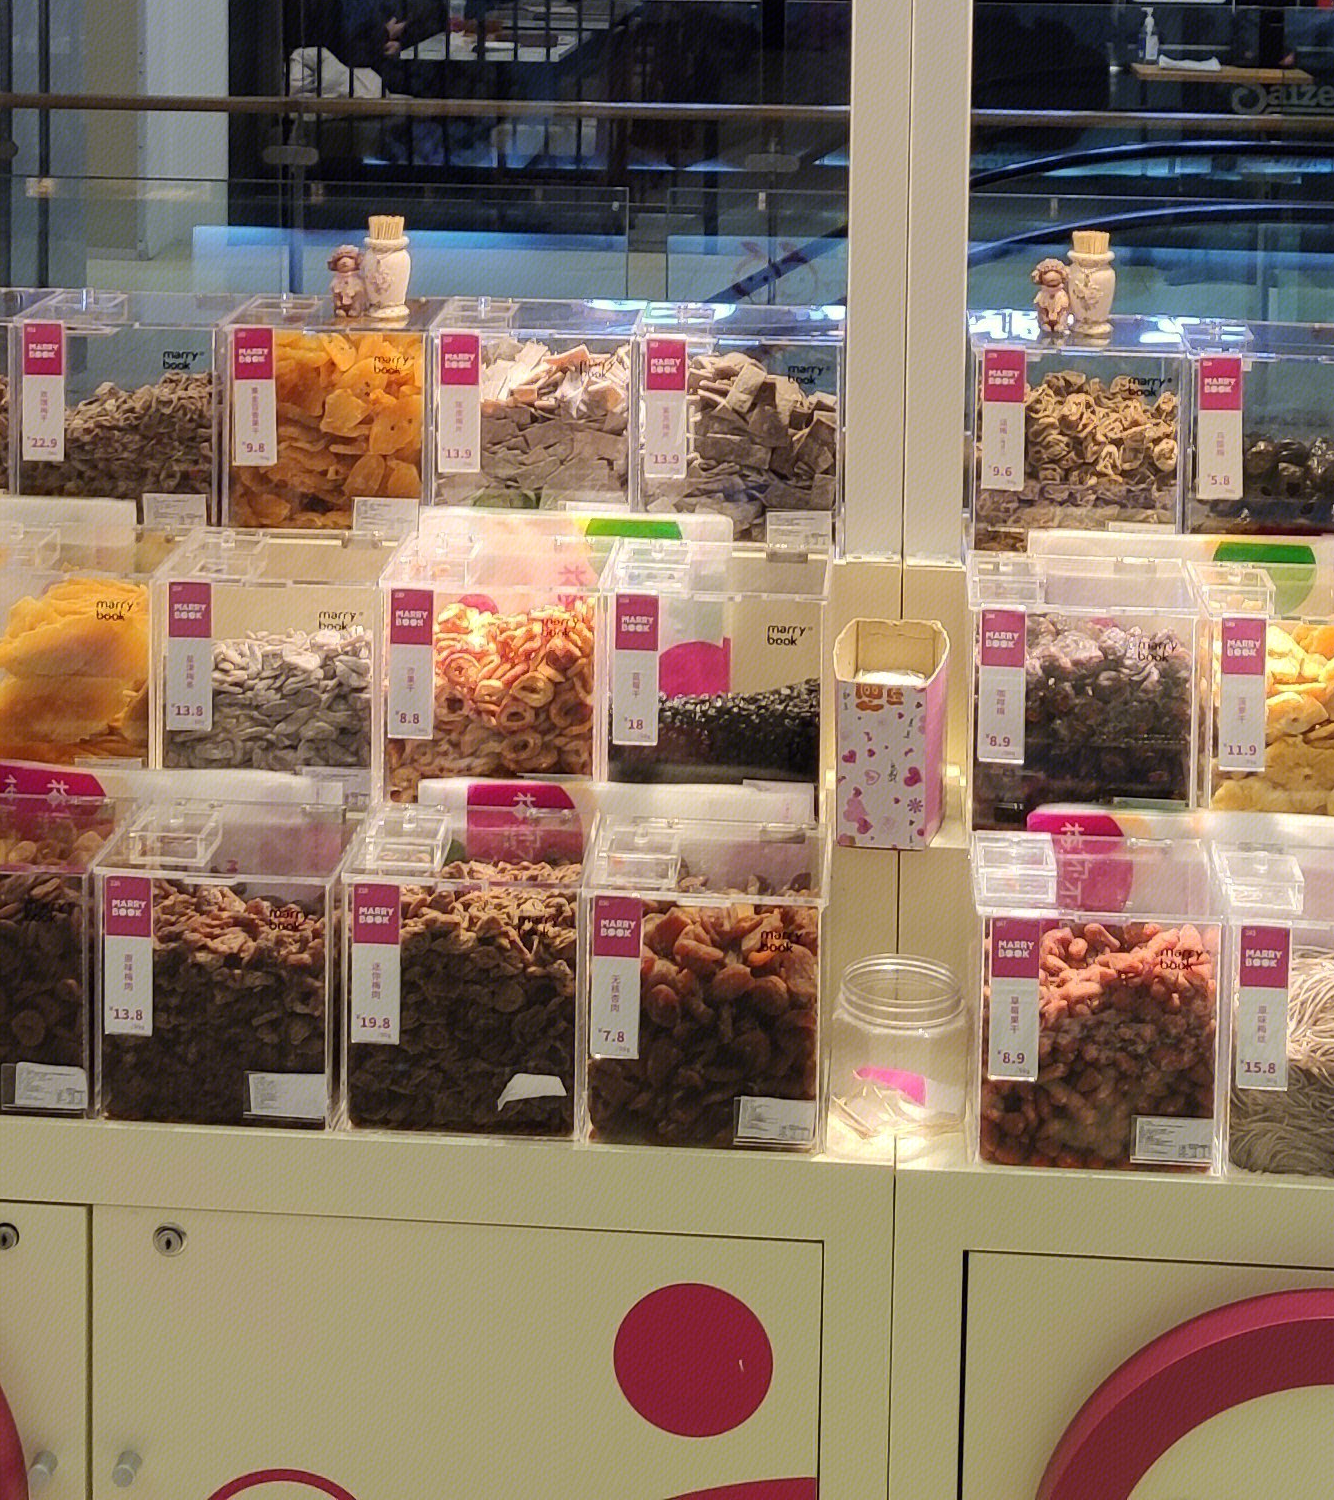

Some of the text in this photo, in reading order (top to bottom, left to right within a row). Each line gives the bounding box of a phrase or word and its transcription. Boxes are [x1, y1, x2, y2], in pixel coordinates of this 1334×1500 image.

[112, 899, 147, 909] MARRY
[112, 907, 142, 917] BOOK
[358, 906, 394, 916] MARRY
[358, 914, 389, 924] BOOK
[600, 918, 636, 929] MARRY
[600, 927, 632, 937] BOOK
[998, 940, 1034, 950] MARRY
[998, 948, 1030, 958] BOOK
[1245, 949, 1282, 959] MARRY
[1245, 957, 1278, 967] BOOK
